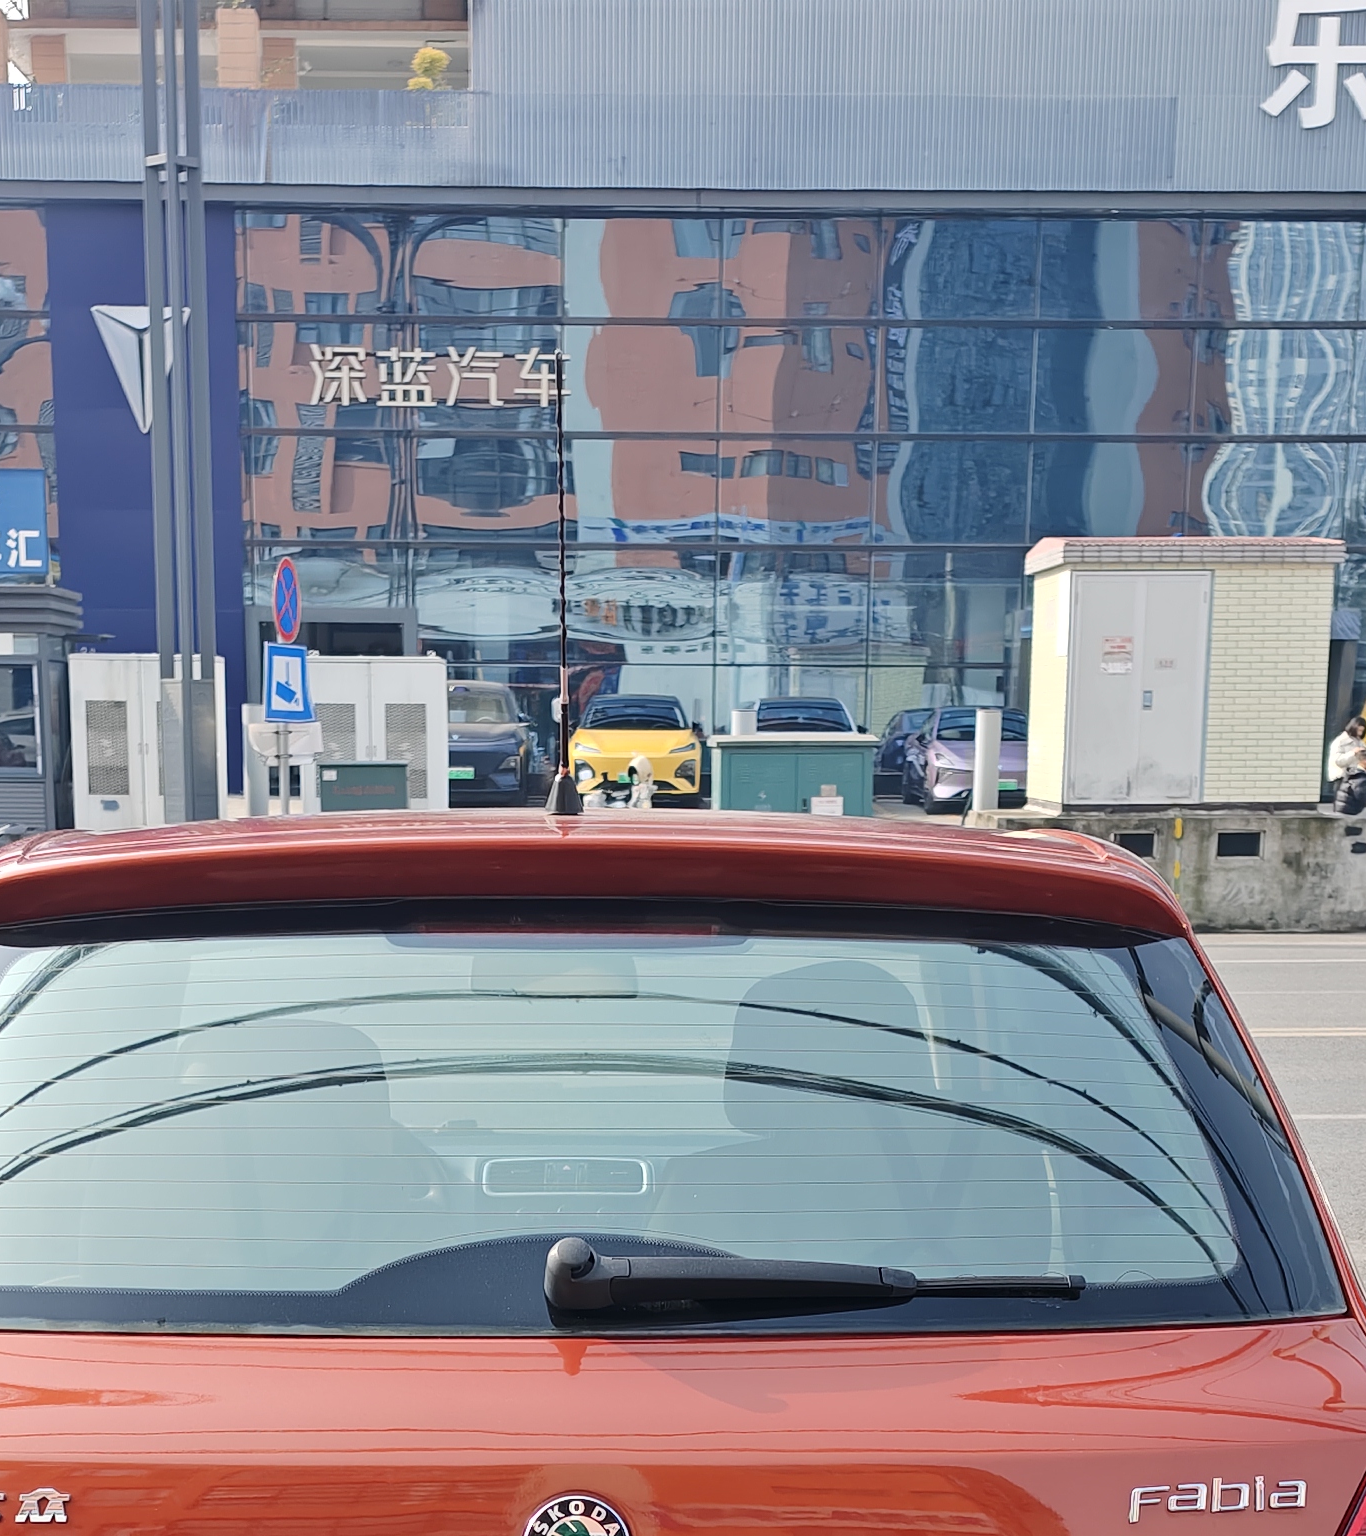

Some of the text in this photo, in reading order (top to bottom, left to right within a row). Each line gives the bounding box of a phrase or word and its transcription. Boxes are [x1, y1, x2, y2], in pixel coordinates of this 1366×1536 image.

[309, 344, 571, 407] 深蓝汽车
[1128, 1475, 1308, 1523] Fabia
